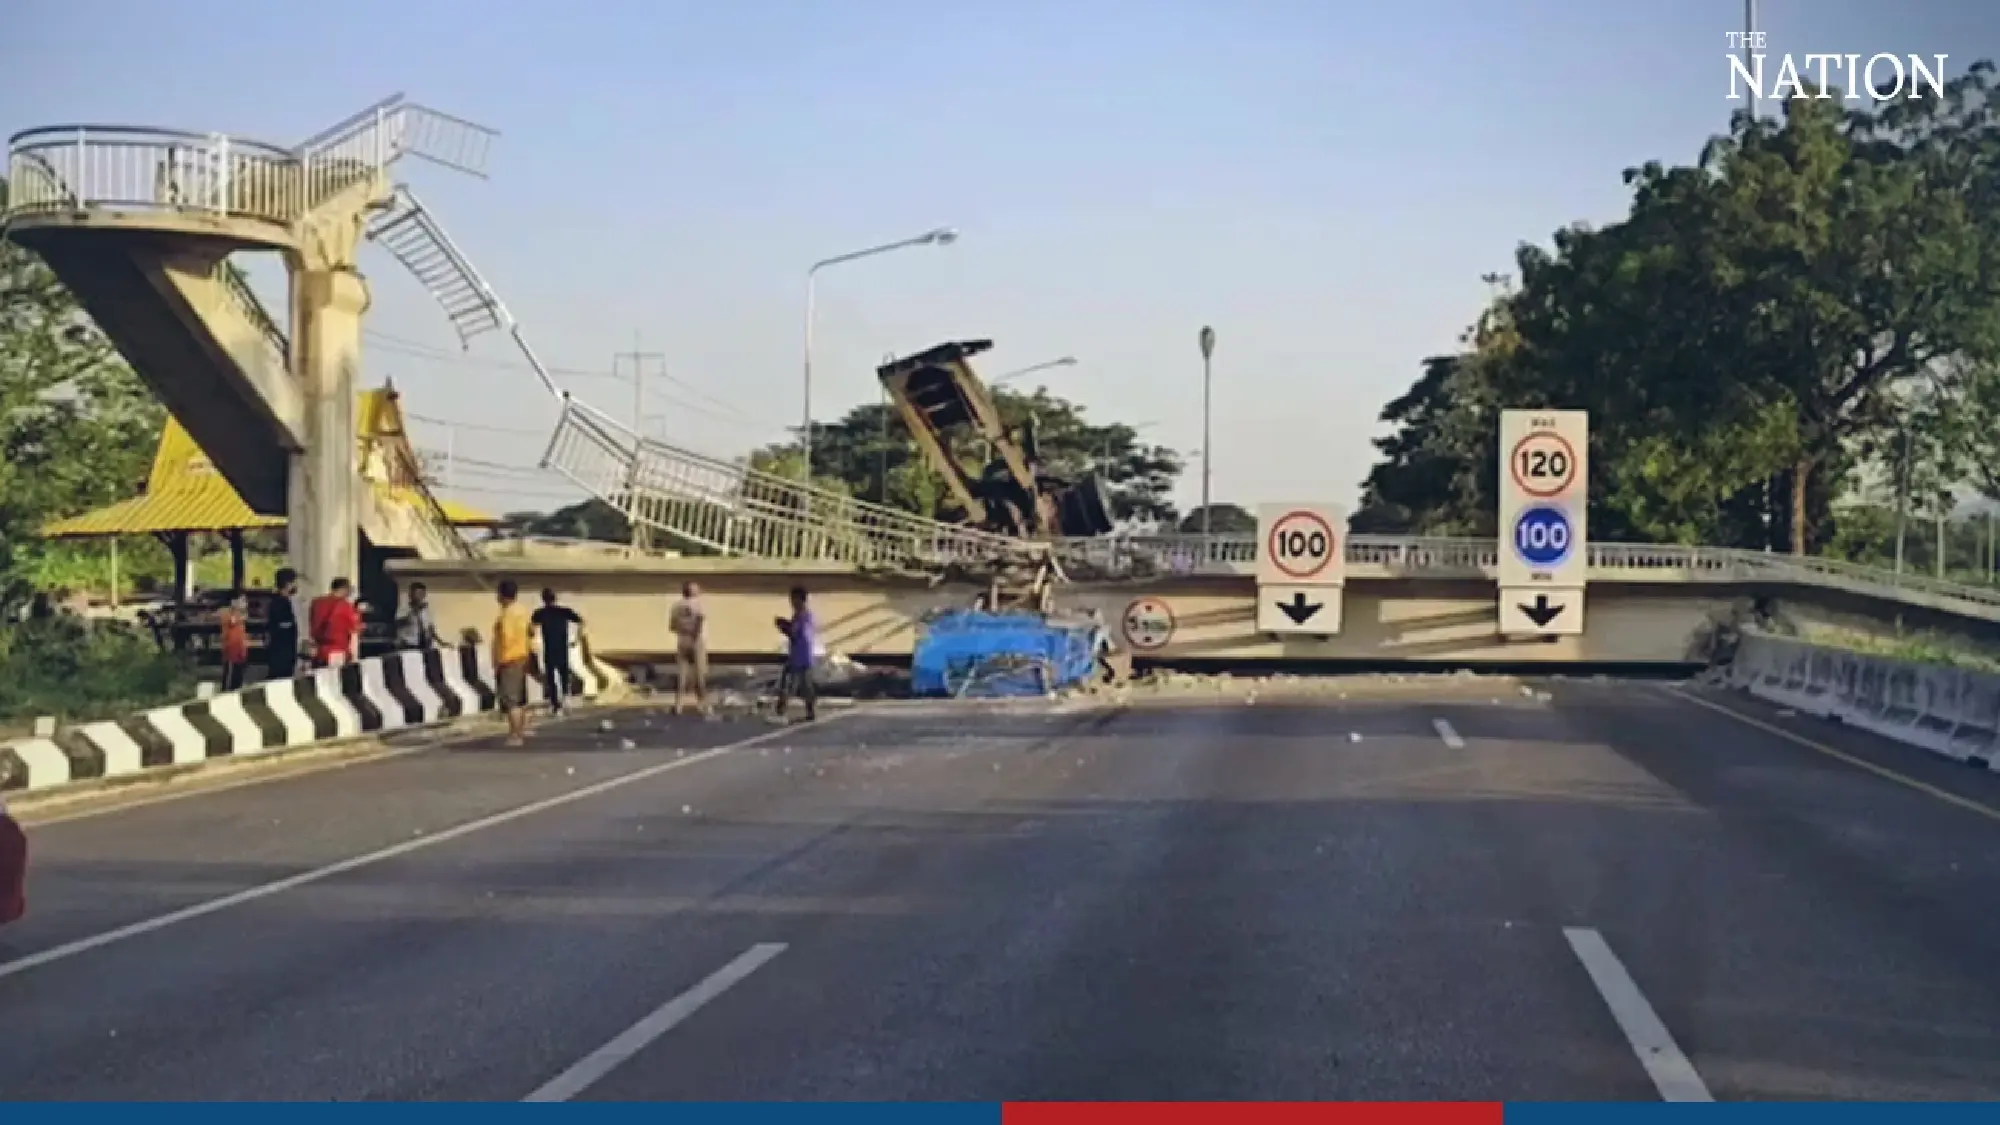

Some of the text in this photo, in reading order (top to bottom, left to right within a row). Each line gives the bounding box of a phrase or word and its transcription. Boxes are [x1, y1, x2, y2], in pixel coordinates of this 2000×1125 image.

[1521, 450, 1567, 477] 120
[1279, 531, 1325, 557] 100
[1519, 522, 1567, 549] 100
